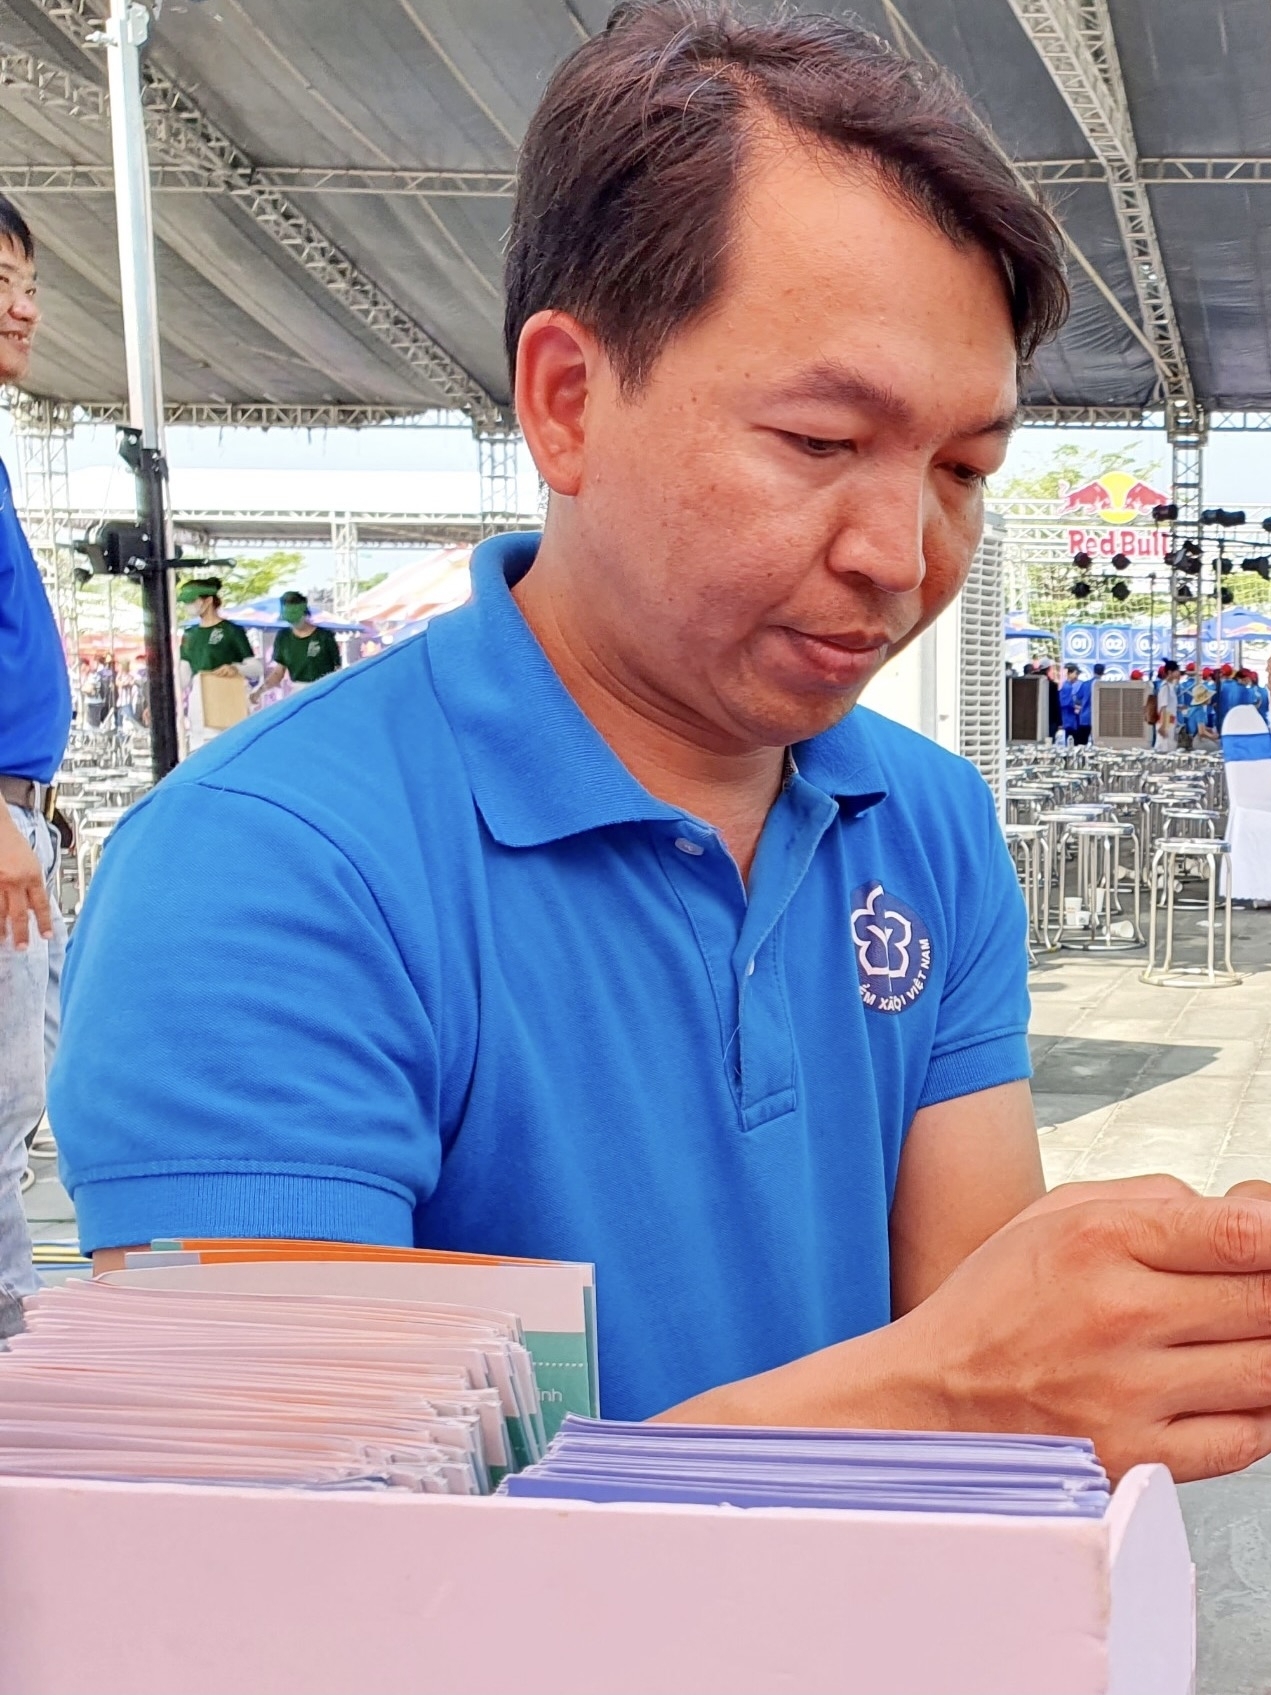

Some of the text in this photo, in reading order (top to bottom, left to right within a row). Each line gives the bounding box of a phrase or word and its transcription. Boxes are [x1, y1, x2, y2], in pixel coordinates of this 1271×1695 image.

[1068, 530, 1170, 556] Red Bull
[1071, 637, 1087, 650] 01
[1106, 637, 1123, 651] 02
[906, 970, 927, 1000] VIỆT
[918, 938, 931, 970] NAM
